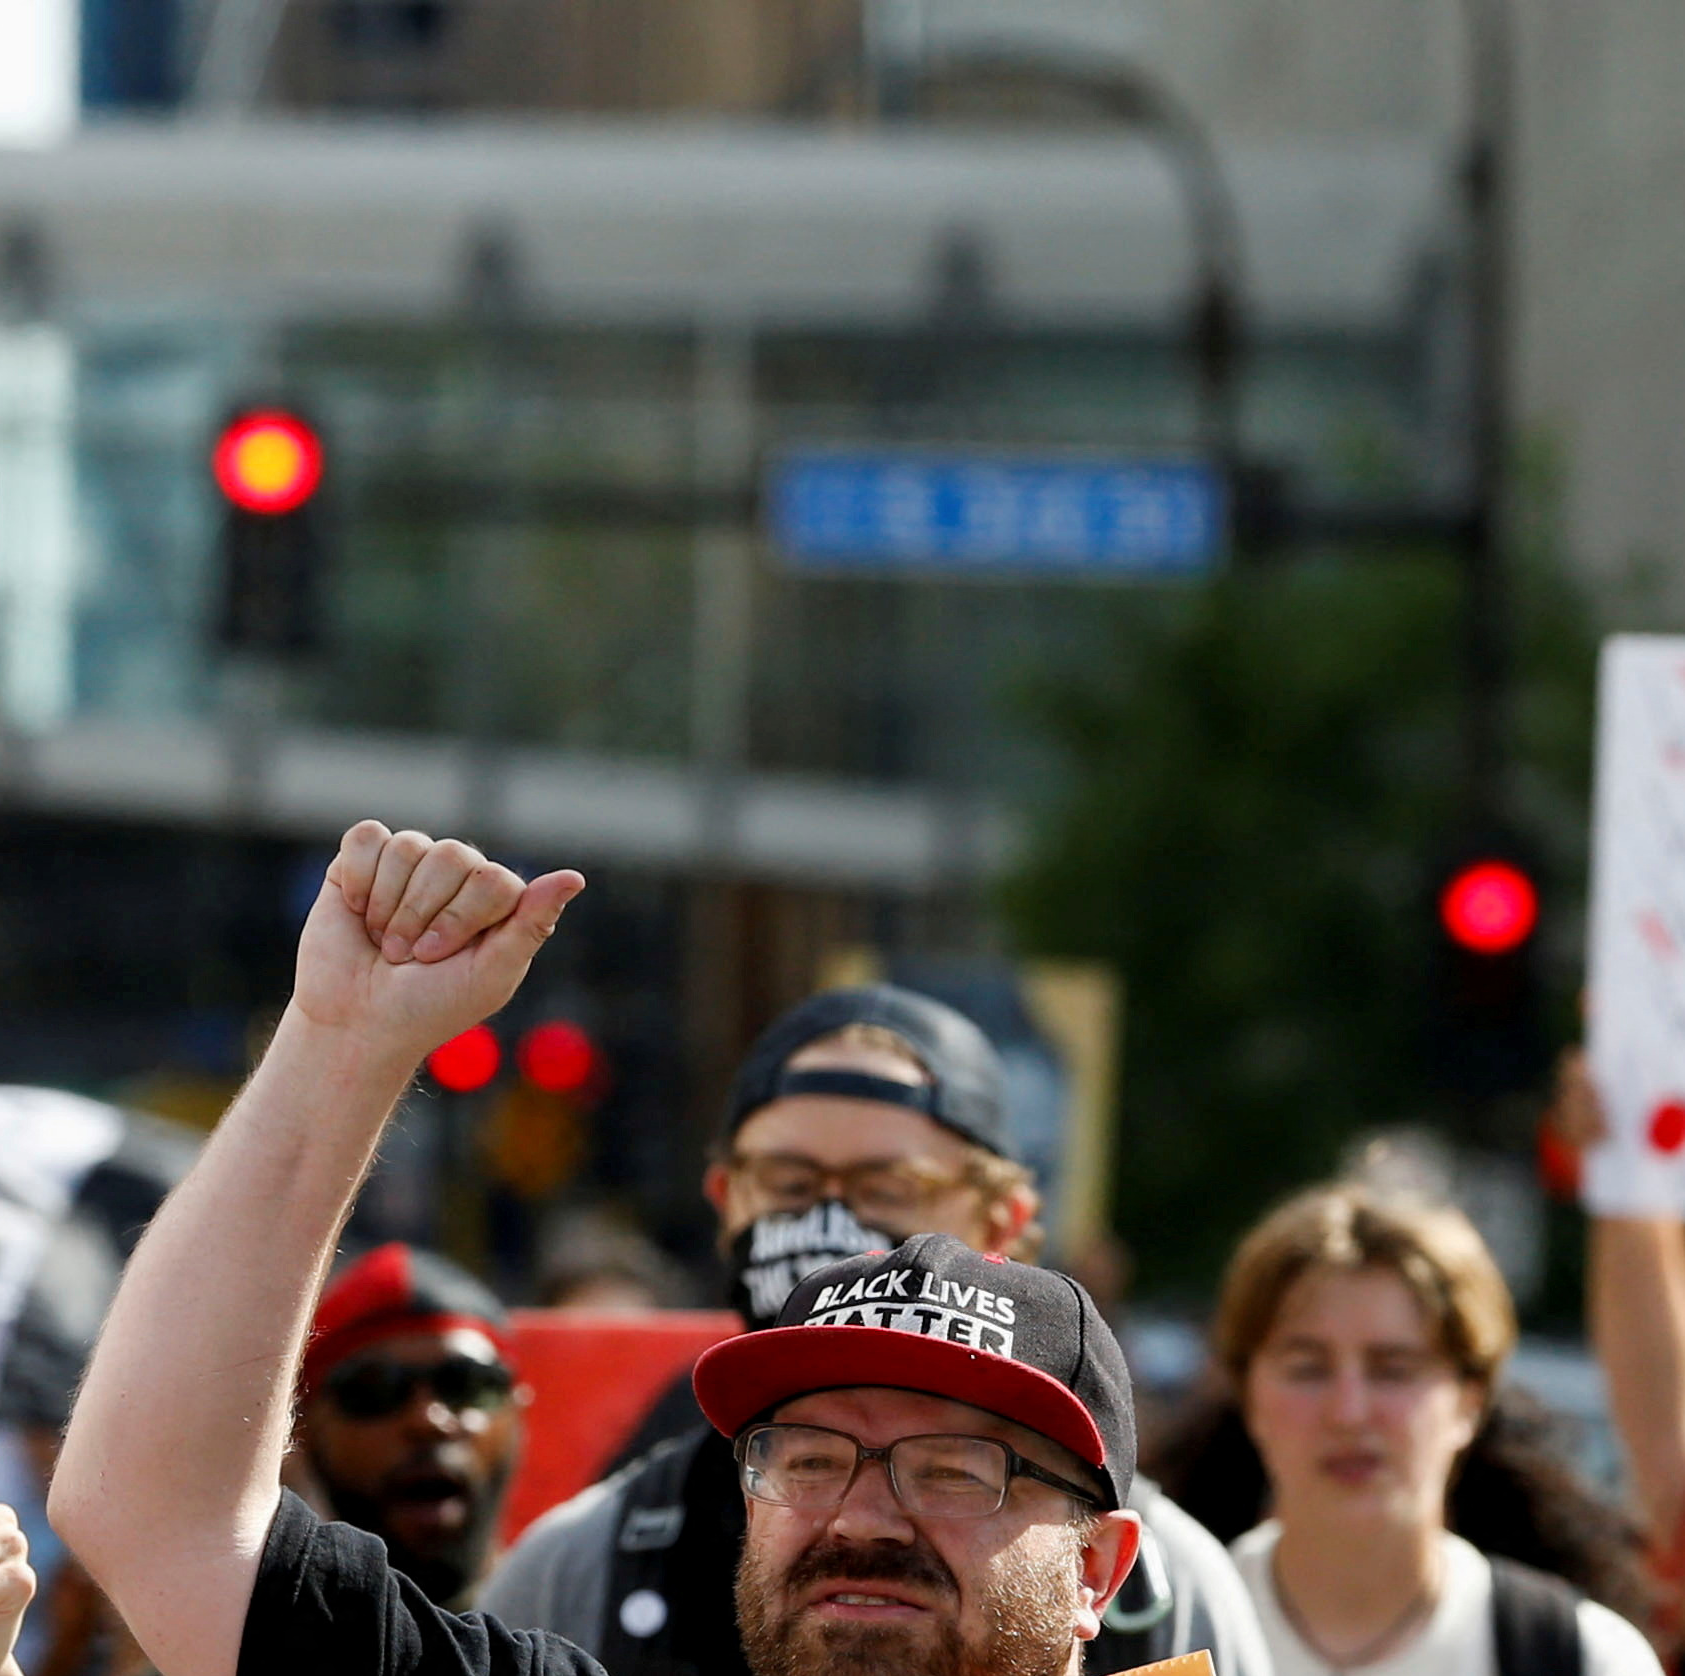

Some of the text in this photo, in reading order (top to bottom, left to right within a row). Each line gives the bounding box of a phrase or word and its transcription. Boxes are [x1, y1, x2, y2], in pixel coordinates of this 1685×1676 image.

[811, 1268, 914, 1315] BLACK
[918, 1271, 1016, 1326] LIVES
[804, 1302, 1014, 1359] ATTER
